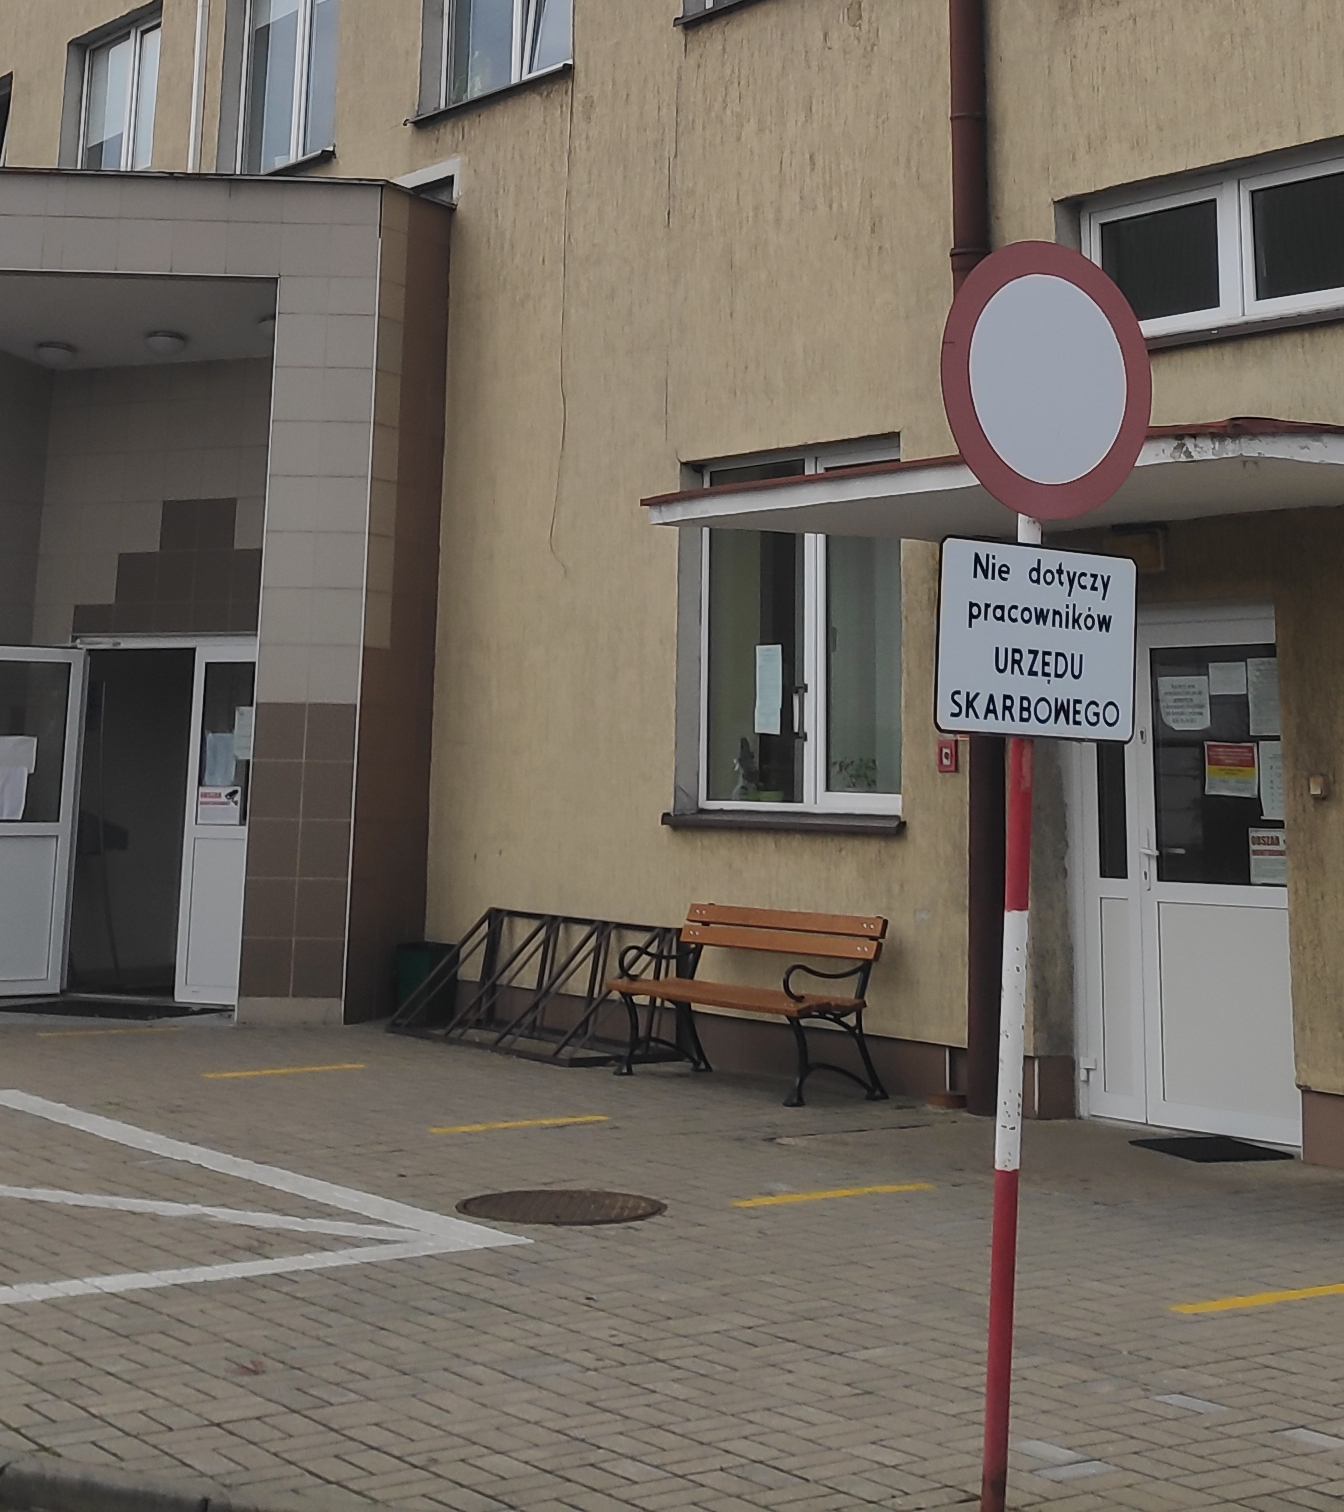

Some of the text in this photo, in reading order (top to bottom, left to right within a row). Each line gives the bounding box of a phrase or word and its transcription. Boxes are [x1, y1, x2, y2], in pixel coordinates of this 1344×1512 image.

[972, 551, 1112, 601] Nie dotyczy
[968, 600, 1113, 633] pracowników
[993, 646, 1084, 685] URZĘDU
[949, 689, 1121, 728] SKARBOWEGO
